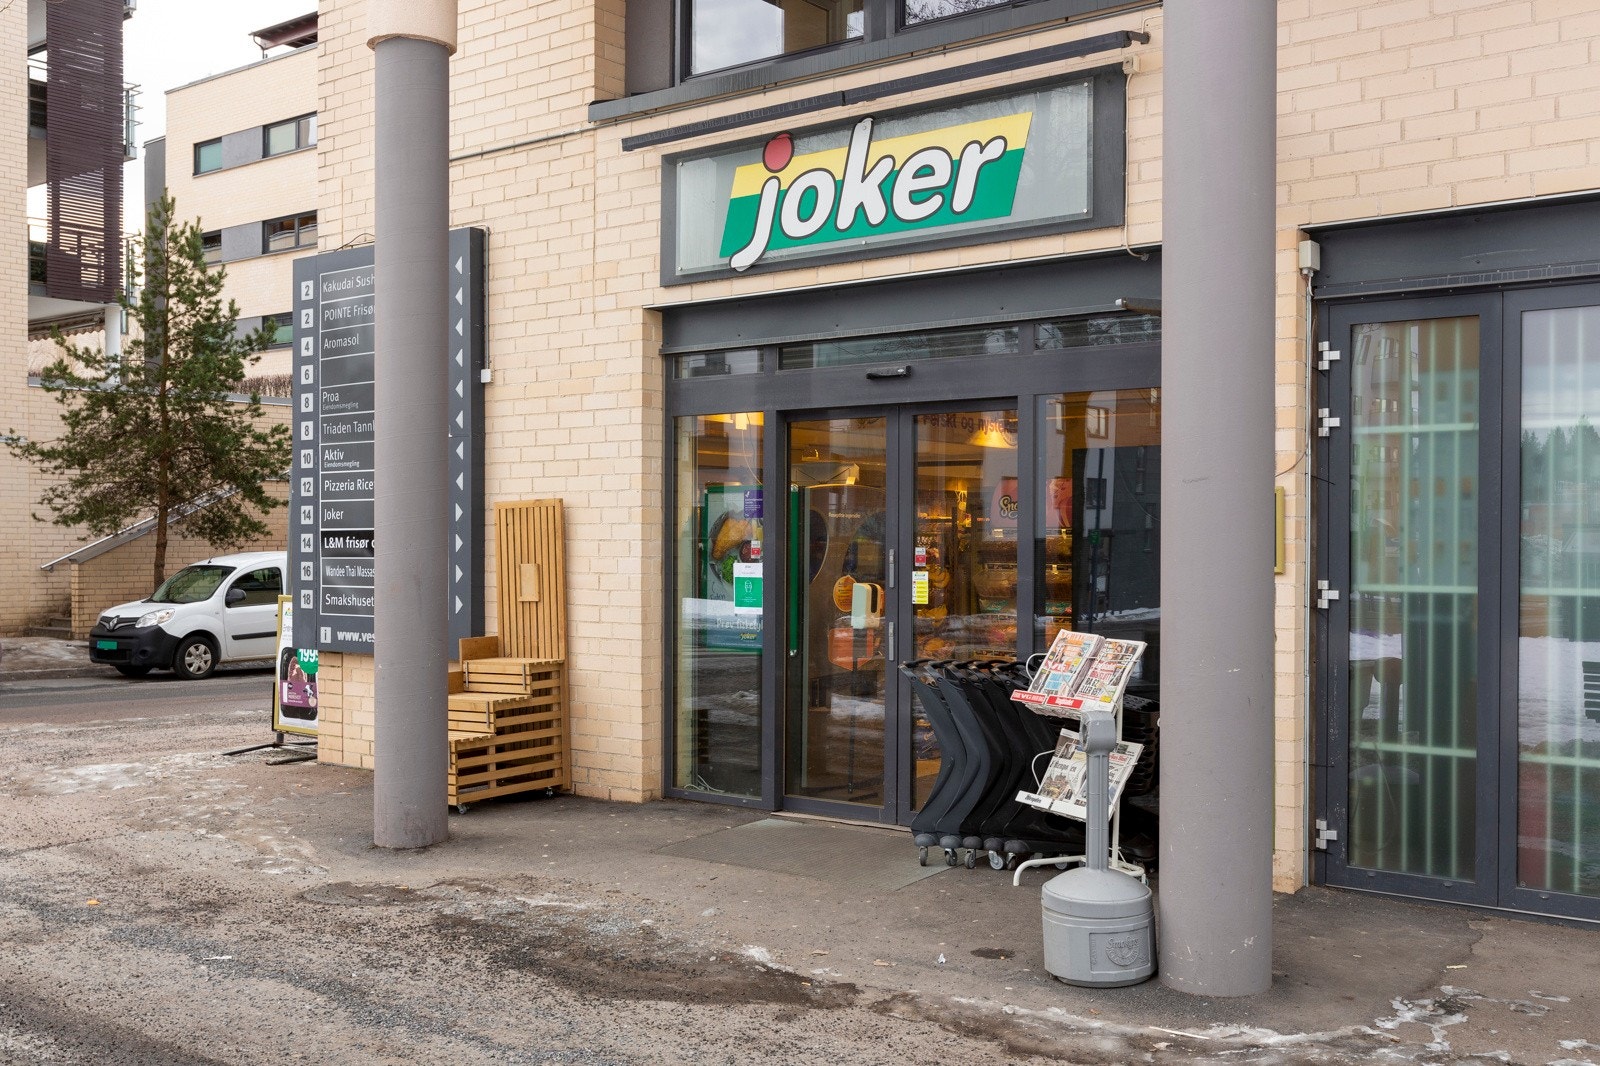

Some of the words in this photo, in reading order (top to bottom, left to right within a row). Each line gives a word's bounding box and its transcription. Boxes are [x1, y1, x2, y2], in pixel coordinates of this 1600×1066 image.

[729, 117, 1008, 272] joker
[323, 276, 354, 293] Kakudai
[324, 305, 352, 322] POINTE
[323, 333, 359, 350] Aromasol
[322, 391, 340, 403] Proa
[323, 422, 352, 435] Triaden
[961, 417, 975, 433] og
[302, 452, 311, 464] 10
[324, 448, 344, 461] Aktiv
[302, 481, 311, 493] 12
[324, 479, 355, 491] Pizzeria
[356, 478, 375, 490] Rice
[302, 509, 311, 521] 14
[324, 508, 344, 521] Joker
[302, 537, 311, 549] 14
[324, 537, 344, 549] L&M
[345, 536, 369, 549] frisør
[302, 565, 311, 577] 16
[325, 565, 345, 577] Wandee
[346, 565, 357, 577] Thai
[302, 593, 311, 605] 18
[325, 593, 375, 607] Smakshuset
